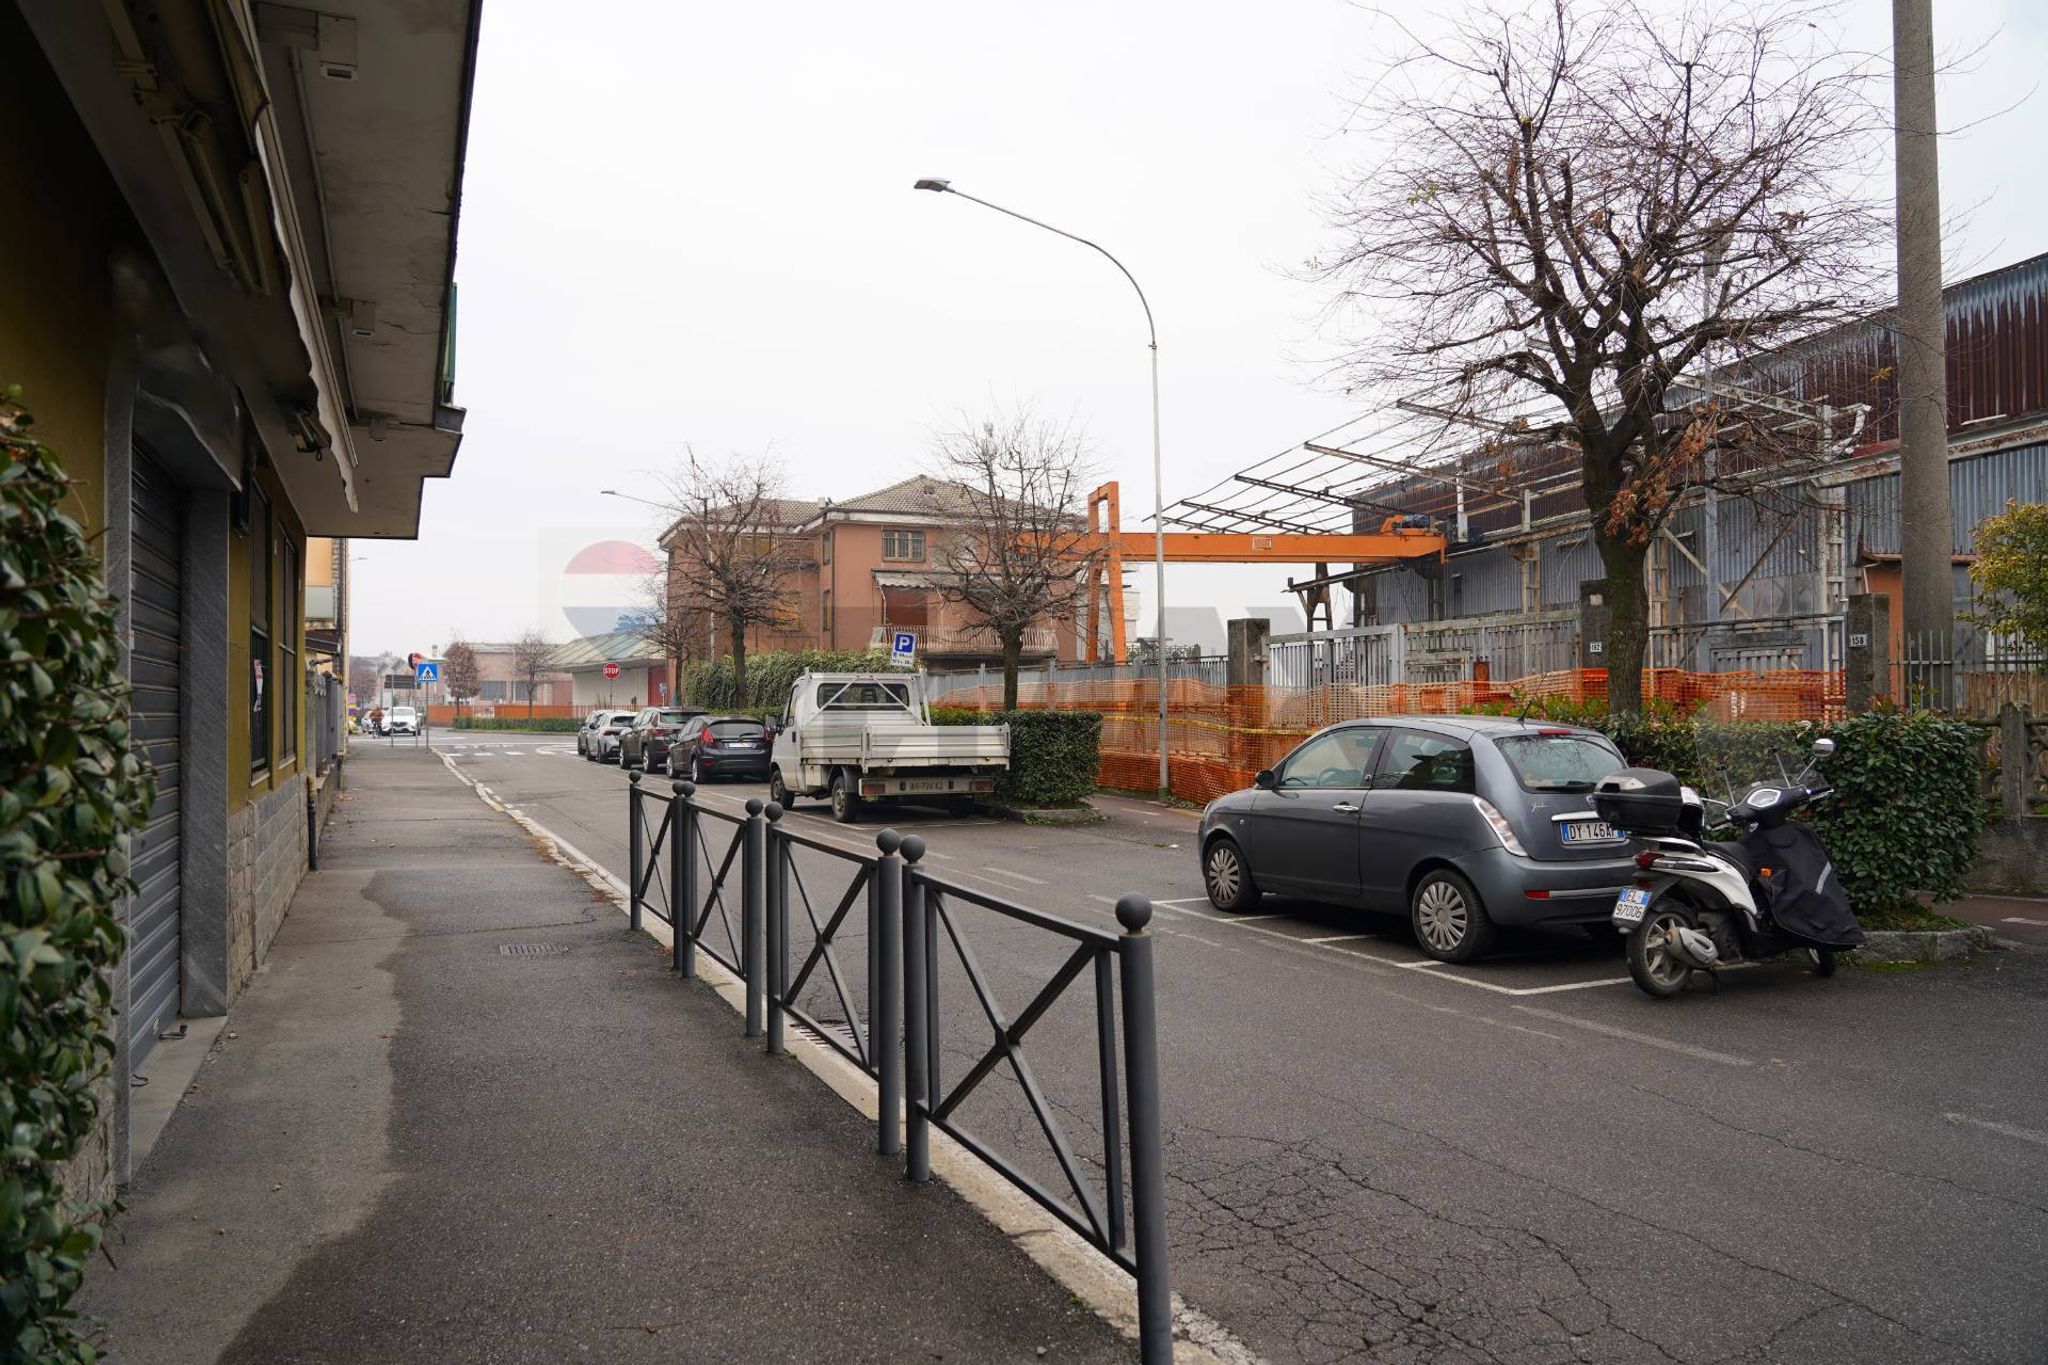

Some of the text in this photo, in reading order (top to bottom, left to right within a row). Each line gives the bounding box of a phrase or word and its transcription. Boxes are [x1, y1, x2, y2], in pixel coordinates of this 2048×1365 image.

[898, 636, 910, 650] P
[1852, 636, 1864, 645] 158
[1569, 824, 1582, 840] DY
